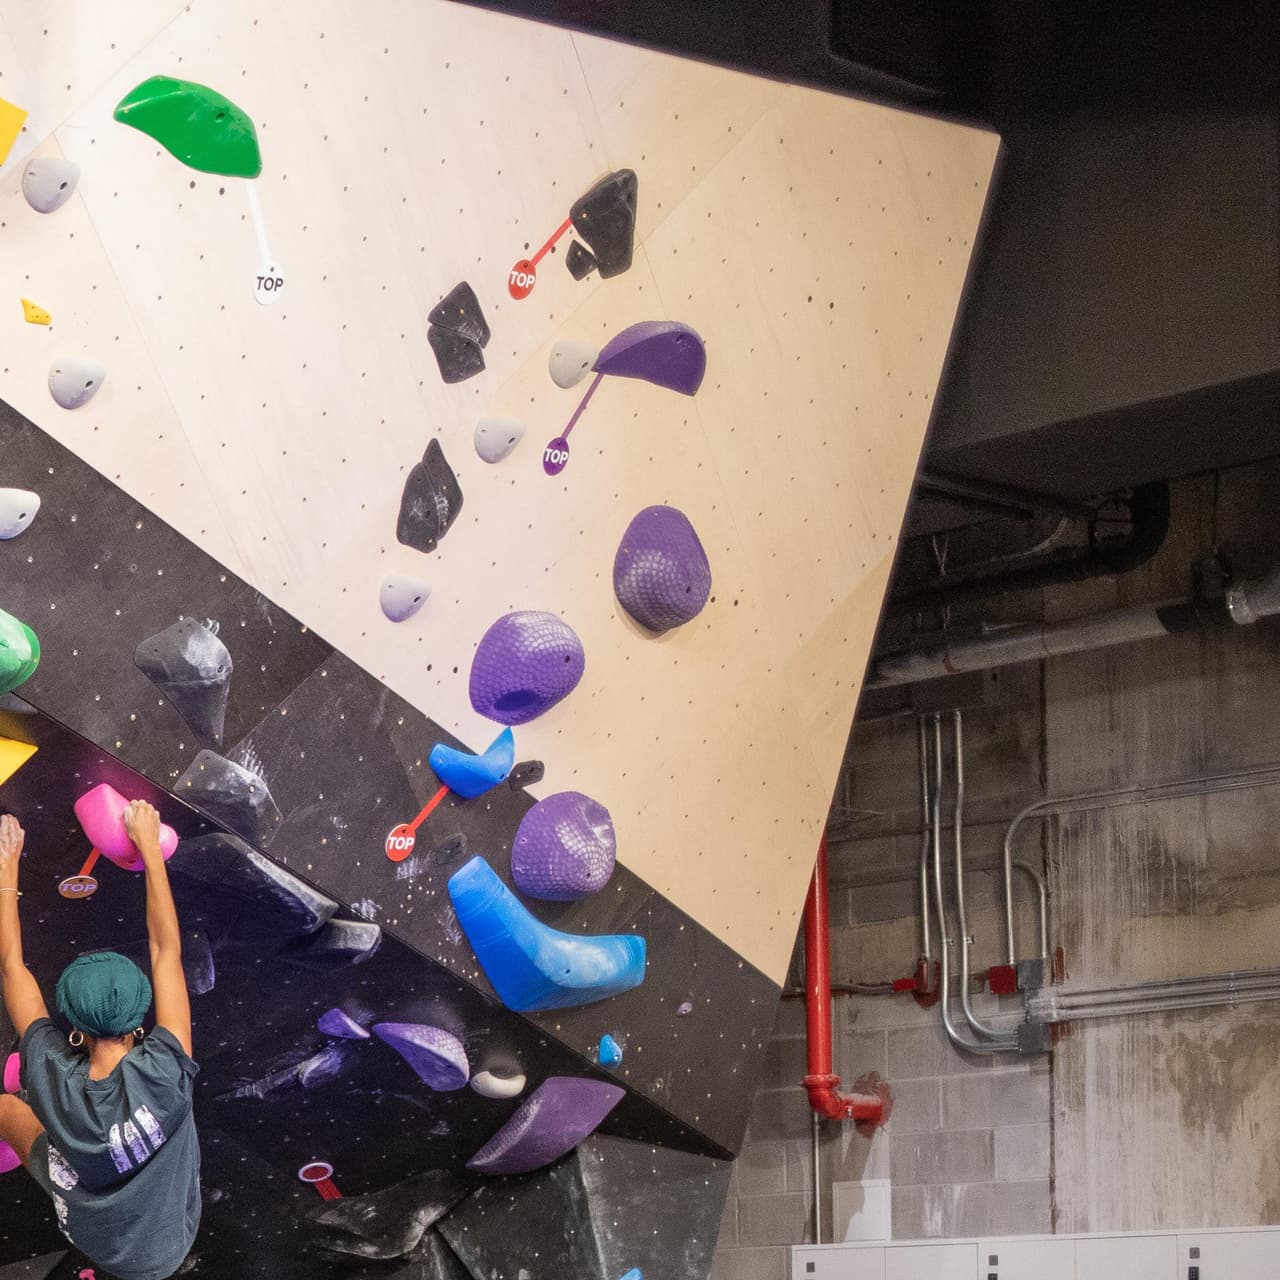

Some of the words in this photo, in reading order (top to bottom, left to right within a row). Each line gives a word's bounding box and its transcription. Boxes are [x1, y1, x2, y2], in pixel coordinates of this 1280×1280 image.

[256, 275, 283, 292] TOP
[509, 271, 535, 288] TOP
[544, 449, 568, 465] TOP
[388, 836, 415, 850] TOP
[62, 883, 96, 892] TOP
